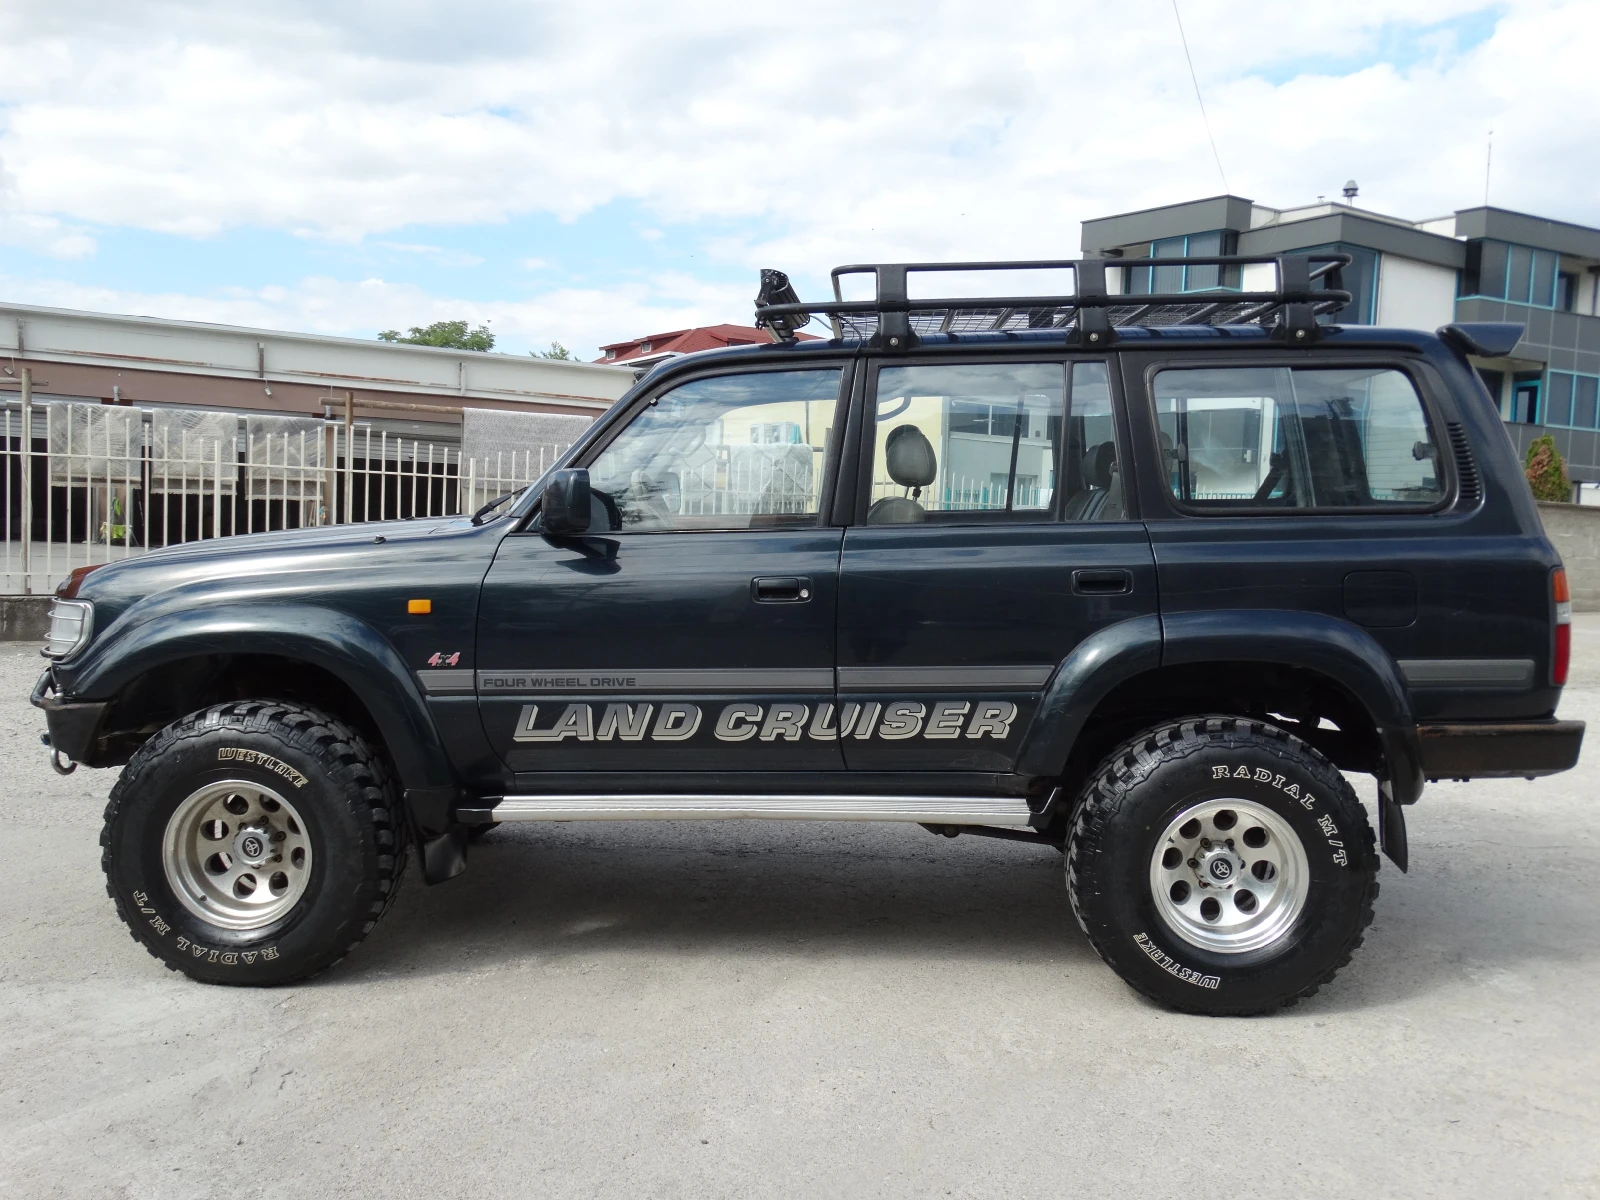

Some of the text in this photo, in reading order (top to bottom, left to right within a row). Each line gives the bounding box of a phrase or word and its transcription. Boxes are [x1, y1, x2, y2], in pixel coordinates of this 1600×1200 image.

[483, 677, 636, 688] FOUR WHEEL DRIVE
[513, 701, 1018, 742] LAND CRUISER
[217, 748, 309, 788] WESTLAKE
[1212, 765, 1348, 867] RADIAL M/T
[133, 890, 280, 965] RADIAL M/T
[1133, 932, 1221, 990] WESTLAKE
